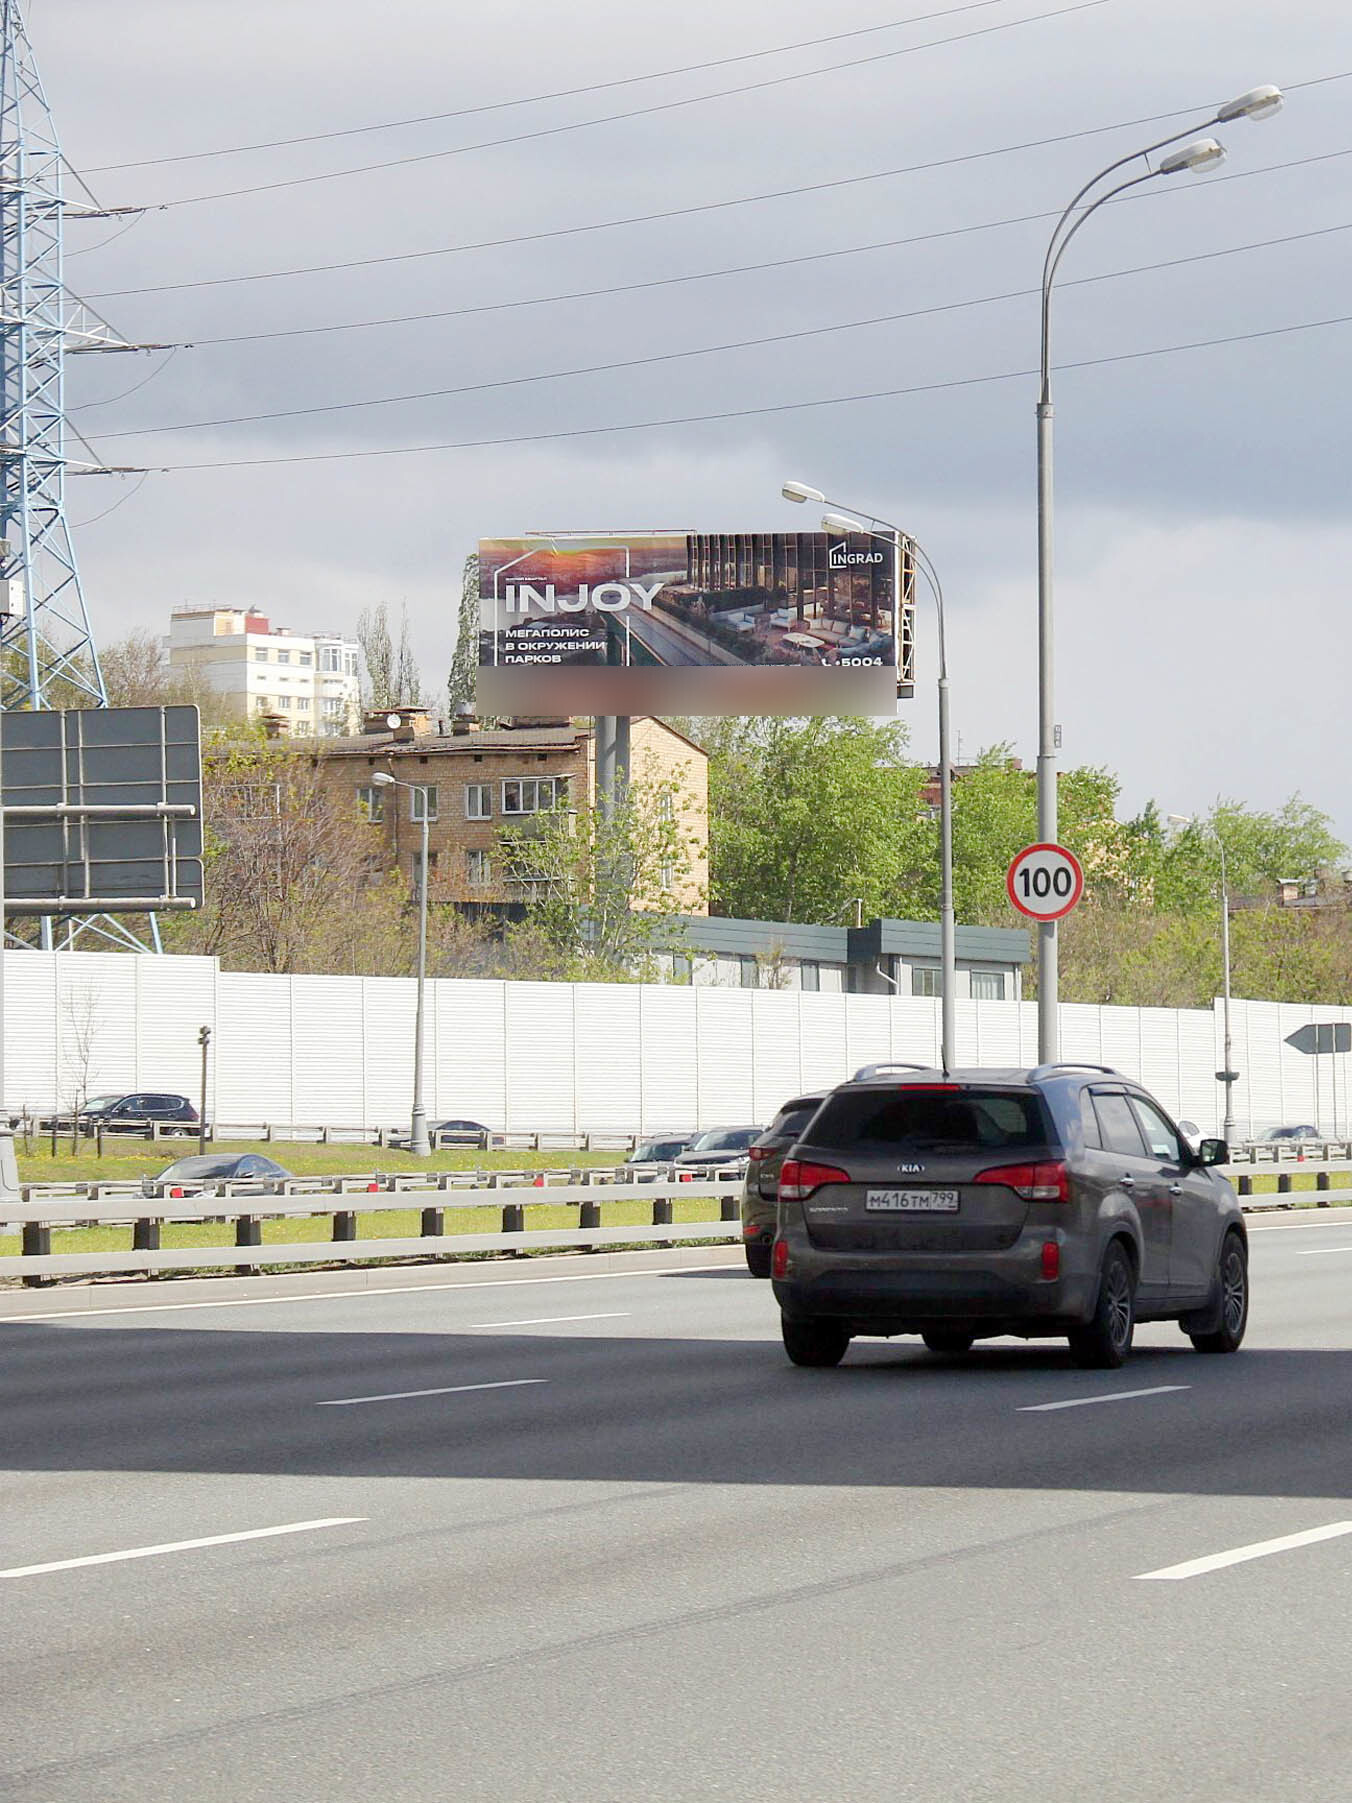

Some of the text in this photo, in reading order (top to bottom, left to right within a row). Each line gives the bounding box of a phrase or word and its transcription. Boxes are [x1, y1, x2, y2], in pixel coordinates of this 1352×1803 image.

[833, 552, 883, 564] INGRAD
[505, 582, 665, 613] INJOY
[505, 628, 590, 638] МЕГАПОЛИС
[505, 641, 606, 651] В ОКРУЖЕНИИ
[505, 654, 562, 664] ПАРКОВ
[1019, 867, 1072, 897] 100
[901, 1164, 921, 1173] KIA
